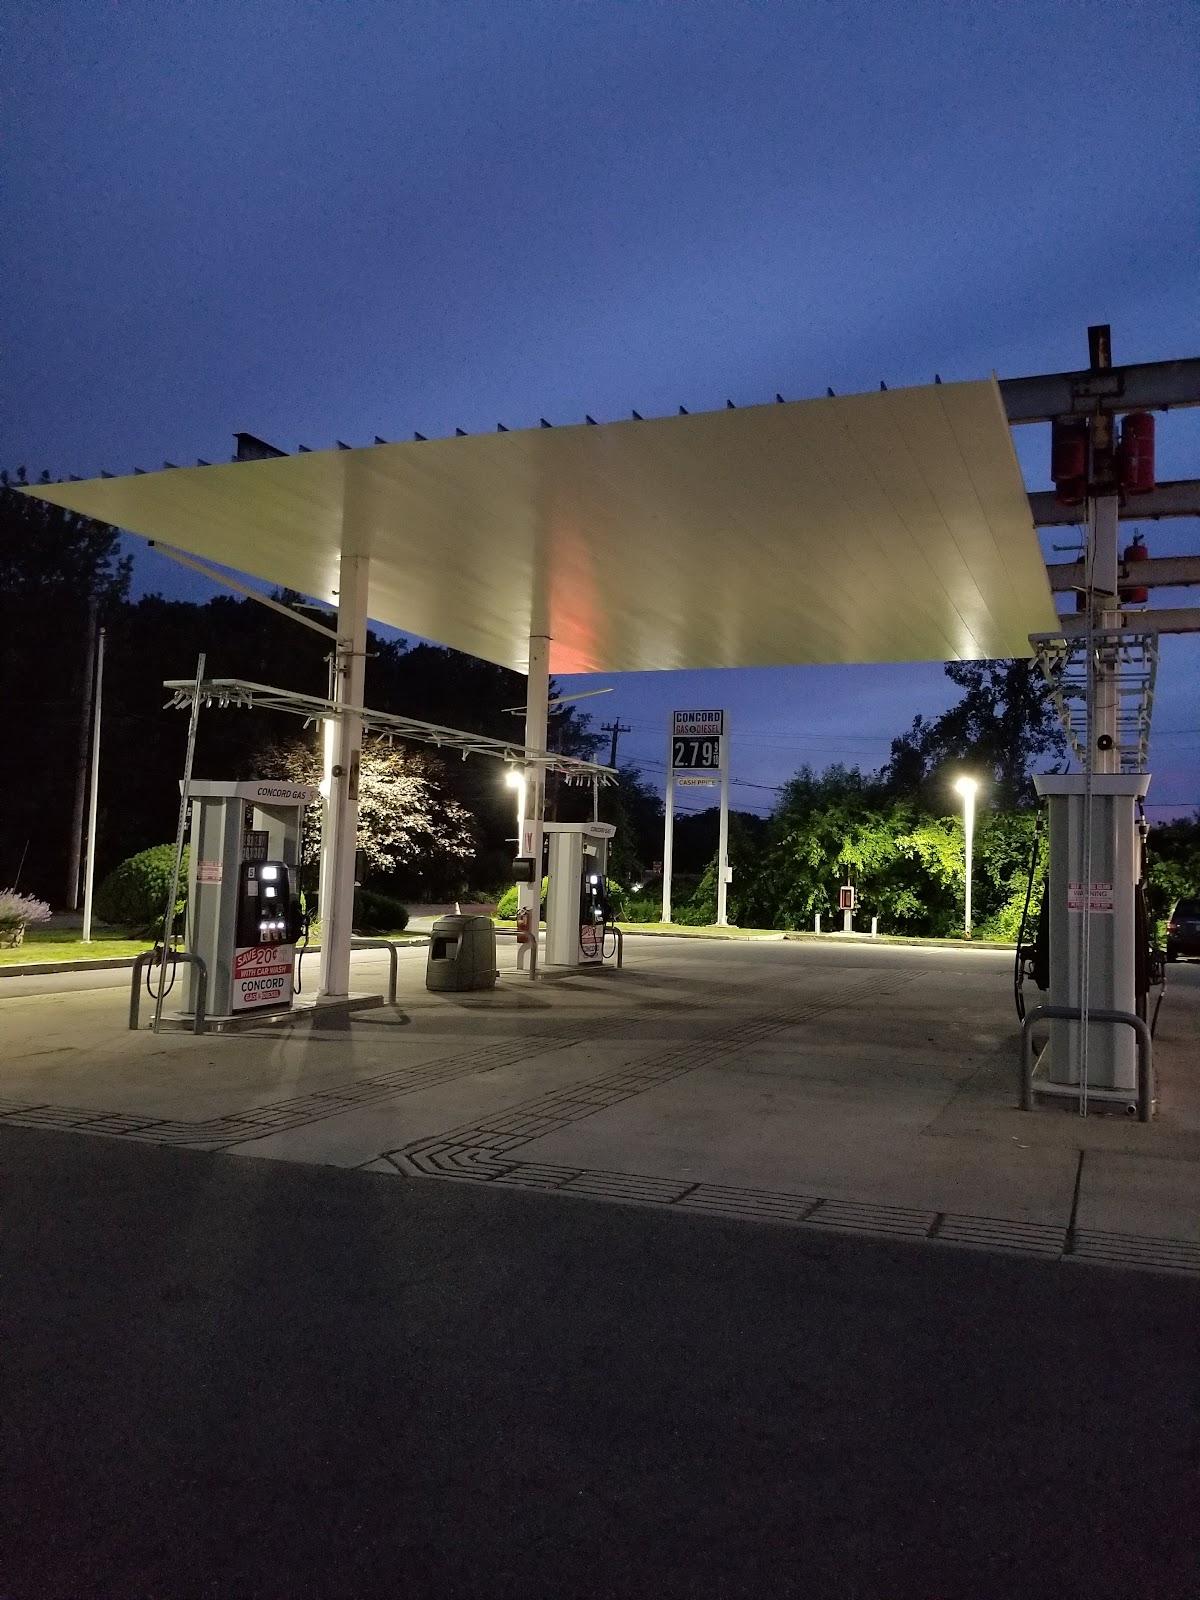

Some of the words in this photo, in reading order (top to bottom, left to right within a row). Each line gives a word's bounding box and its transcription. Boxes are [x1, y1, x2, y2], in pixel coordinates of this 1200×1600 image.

[676, 712, 720, 722] CONCORD
[676, 725, 689, 734] GAS
[696, 724, 720, 734] DIESEL
[674, 742, 713, 766] 2.79
[257, 787, 292, 799] CONCORD
[292, 791, 306, 800] GAS
[237, 948, 258, 967] SAVE
[256, 947, 278, 965] 20¢
[240, 969, 256, 978] WITH
[256, 967, 270, 976] CAR
[270, 965, 287, 975] WASH
[241, 977, 285, 992] CONCORD
